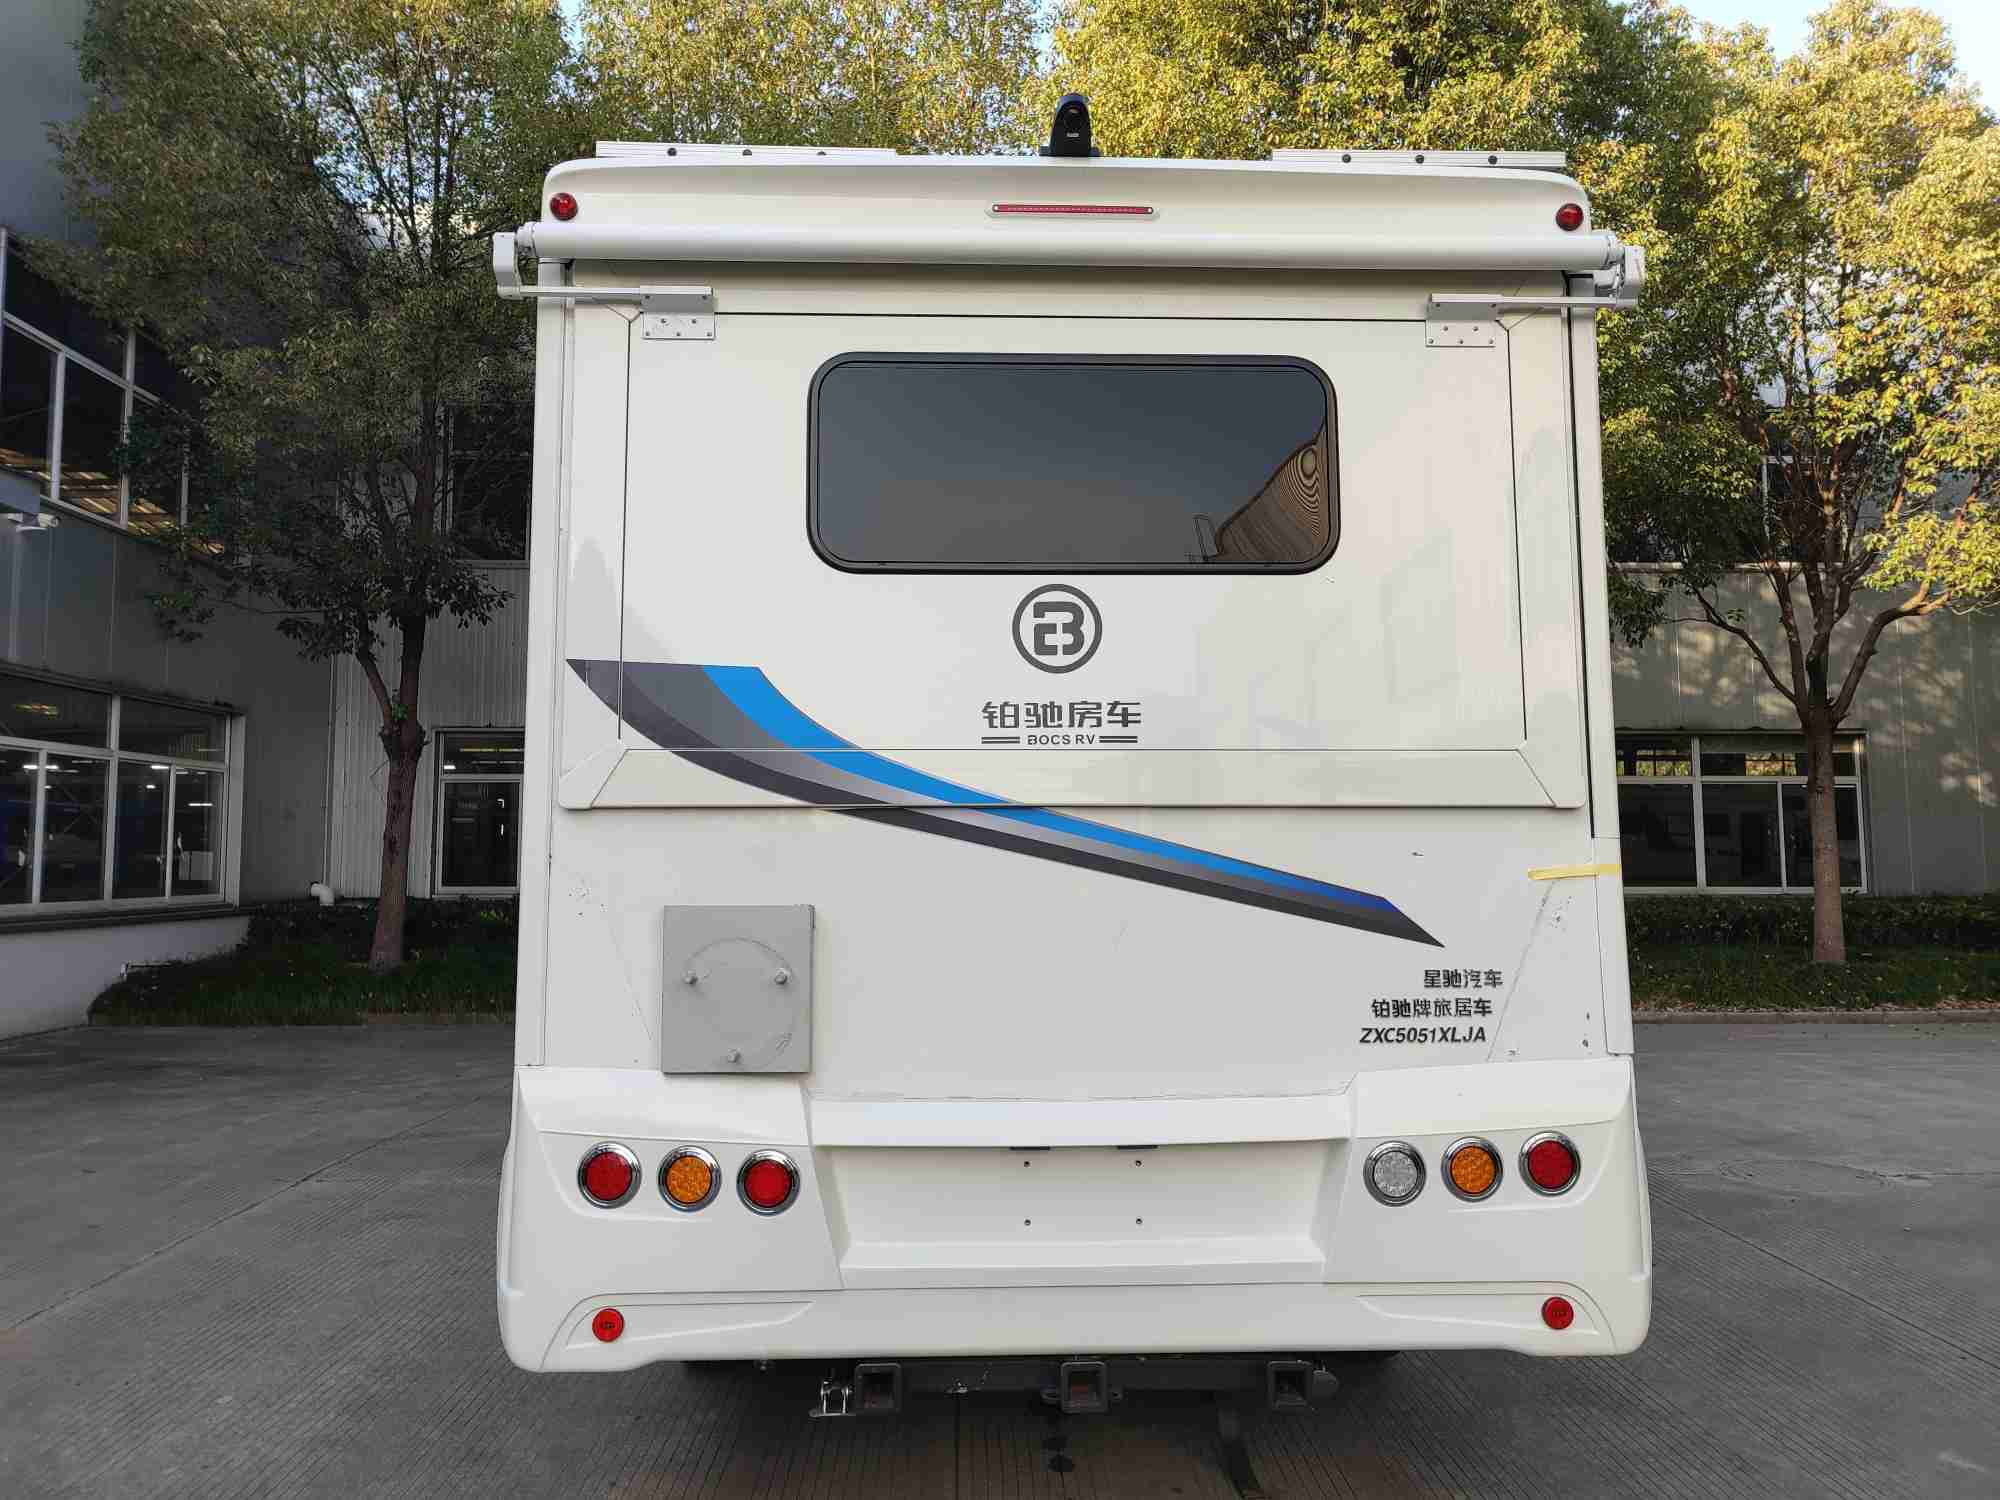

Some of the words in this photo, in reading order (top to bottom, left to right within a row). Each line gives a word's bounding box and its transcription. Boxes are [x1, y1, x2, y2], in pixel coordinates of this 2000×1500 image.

[981, 700, 1142, 729] 铂驰房车
[1027, 734, 1071, 745] BOCS
[1075, 734, 1096, 745] RV
[1423, 969, 1503, 988] 星驰汽车
[1371, 998, 1493, 1018] 铂驰牌旅居车
[1359, 1026, 1487, 1043] ZXC5051XLJA
